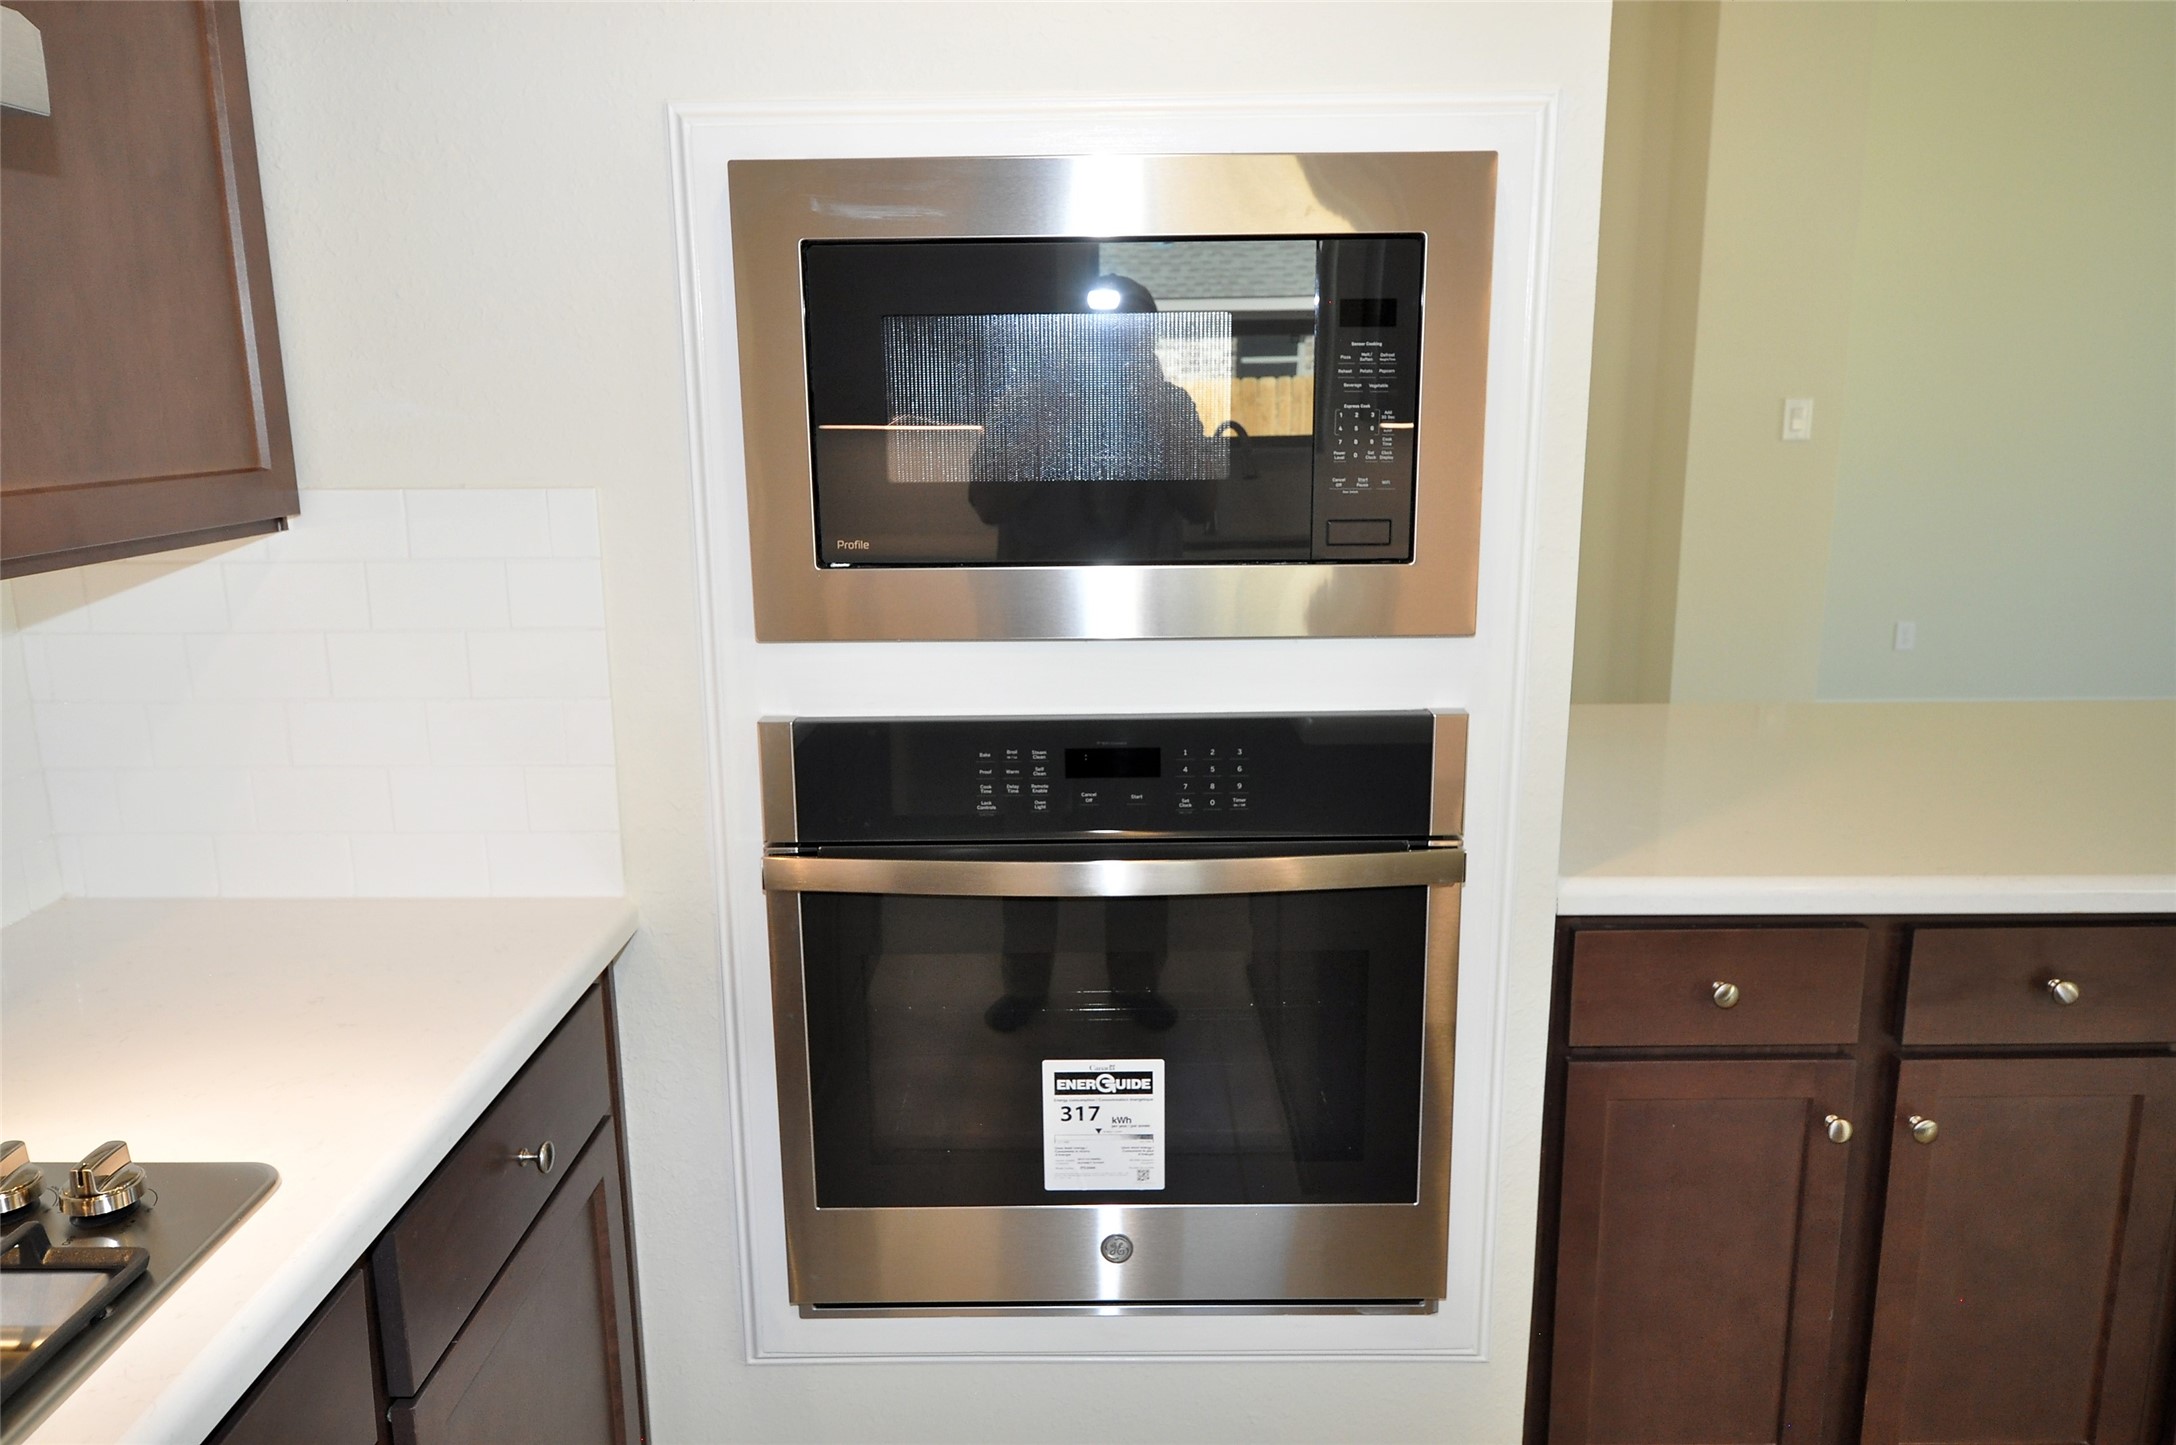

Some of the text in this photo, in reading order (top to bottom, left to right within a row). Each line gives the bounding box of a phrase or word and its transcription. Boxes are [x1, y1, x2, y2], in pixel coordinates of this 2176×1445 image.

[837, 540, 870, 550] Profile
[1210, 748, 1215, 756] 2
[1237, 748, 1243, 756] 3
[1210, 765, 1215, 773] 5
[1210, 782, 1215, 790] 8
[1236, 782, 1243, 790] 9
[1056, 1073, 1152, 1094] ENERGUIDE
[1060, 1105, 1100, 1122] 317
[1111, 1116, 1132, 1124] kWh
